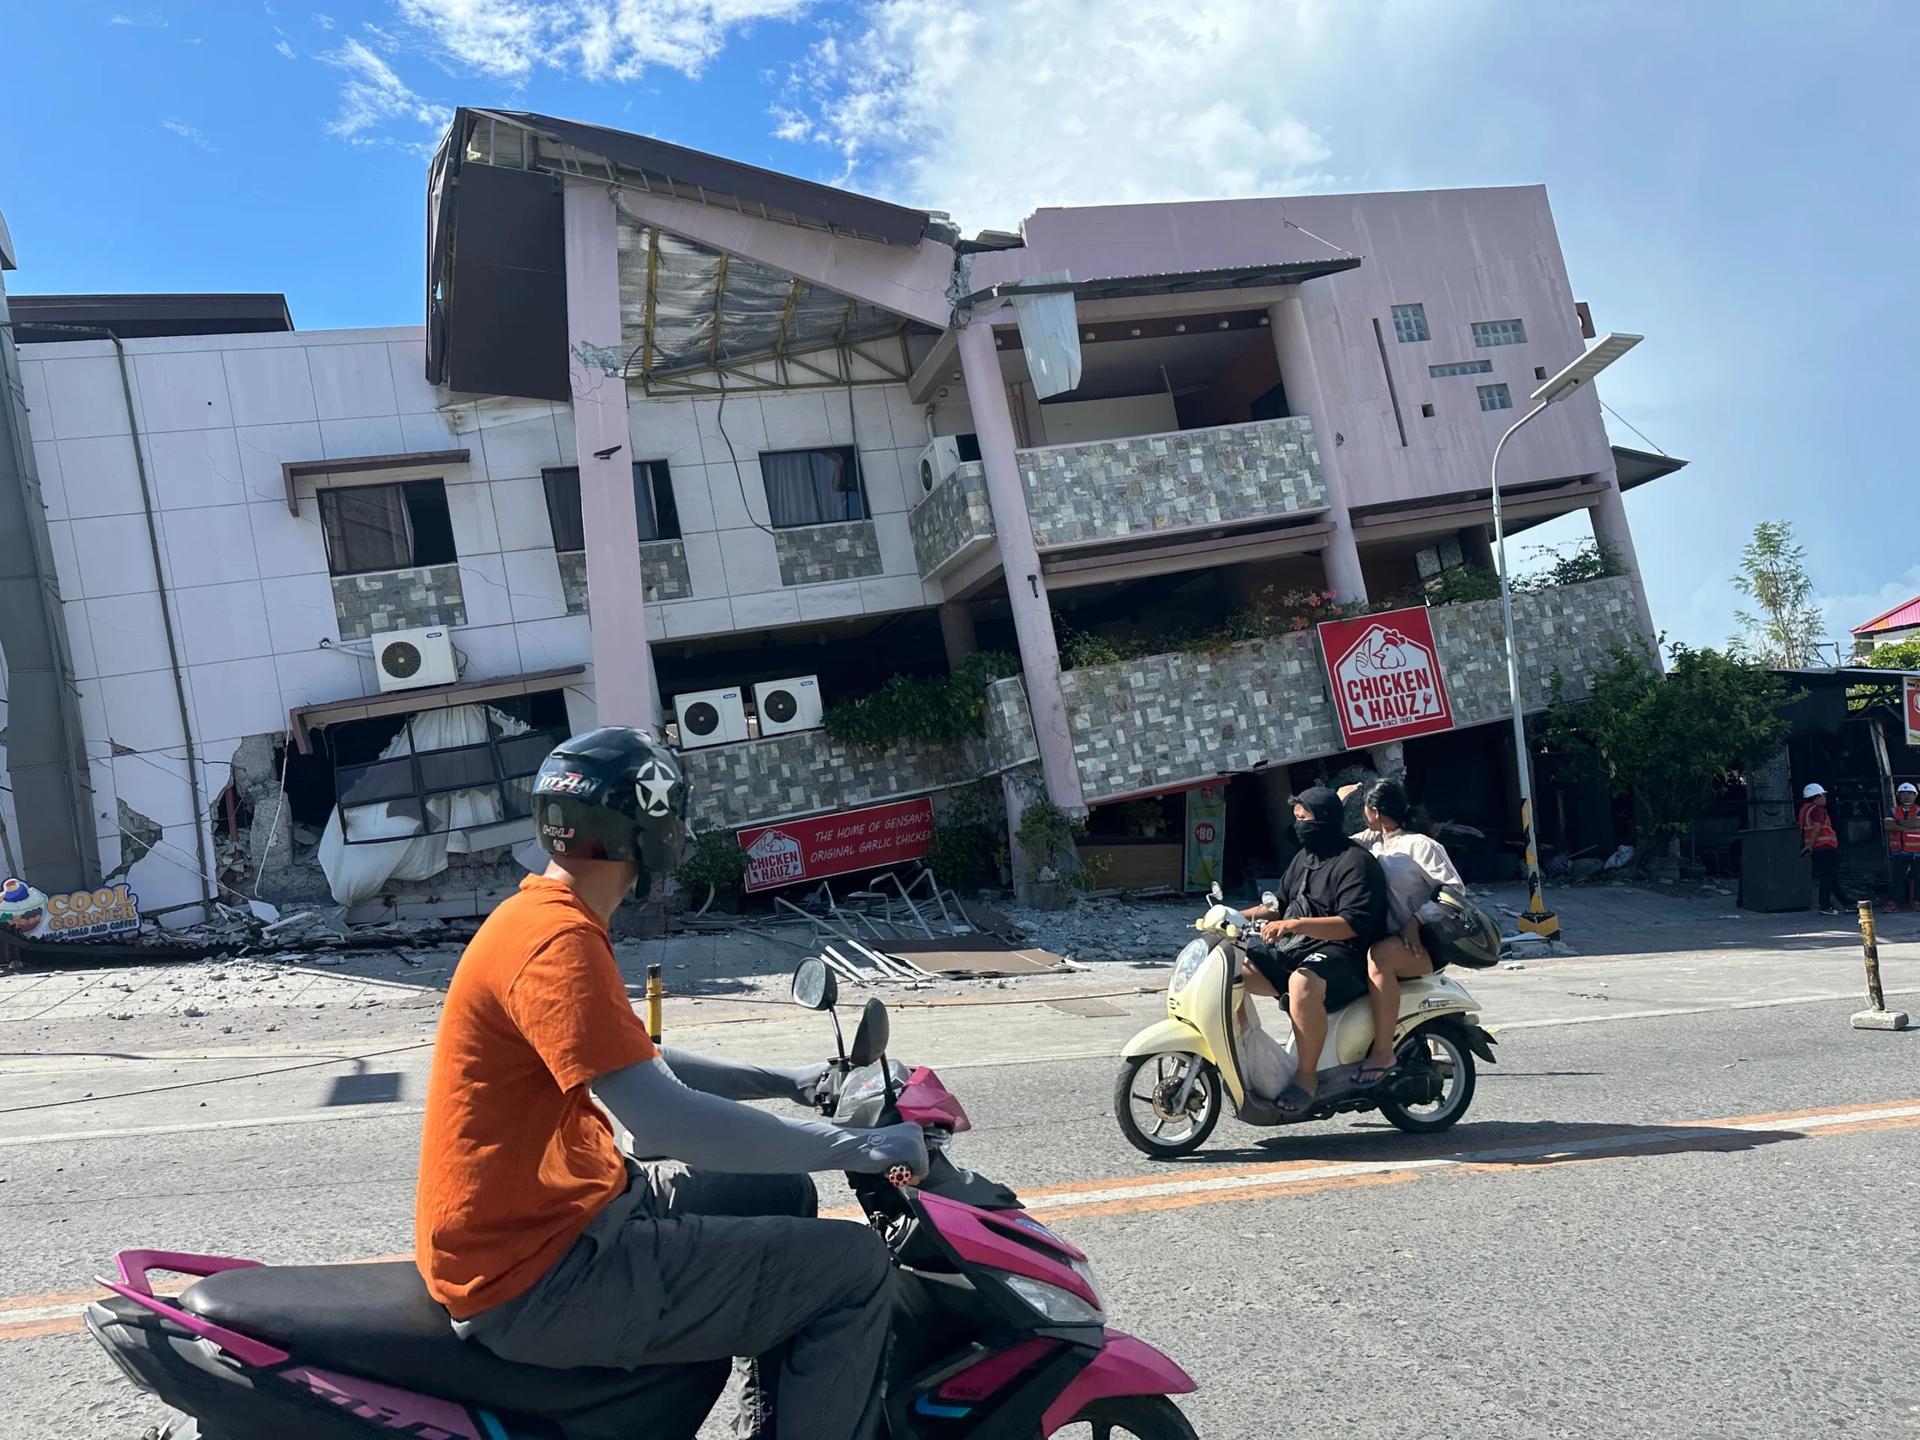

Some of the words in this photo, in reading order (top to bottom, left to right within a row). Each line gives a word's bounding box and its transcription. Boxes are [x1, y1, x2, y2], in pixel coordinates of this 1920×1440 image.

[1347, 668, 1430, 702] CHICKEN
[1368, 693, 1420, 722] HAUZ
[815, 830, 834, 842] THE
[837, 824, 865, 839] HOME
[869, 820, 881, 832] OF
[884, 810, 931, 829] GENSAN'S
[751, 851, 798, 870] CHICKEN
[810, 845, 855, 863] ORIGINAL
[859, 837, 893, 853] GARLIC
[761, 864, 791, 880] HAUZ
[47, 884, 135, 916] COOL
[48, 905, 136, 931] CORNER
[91, 925, 108, 934] AND
[110, 919, 137, 930] COFFEE
